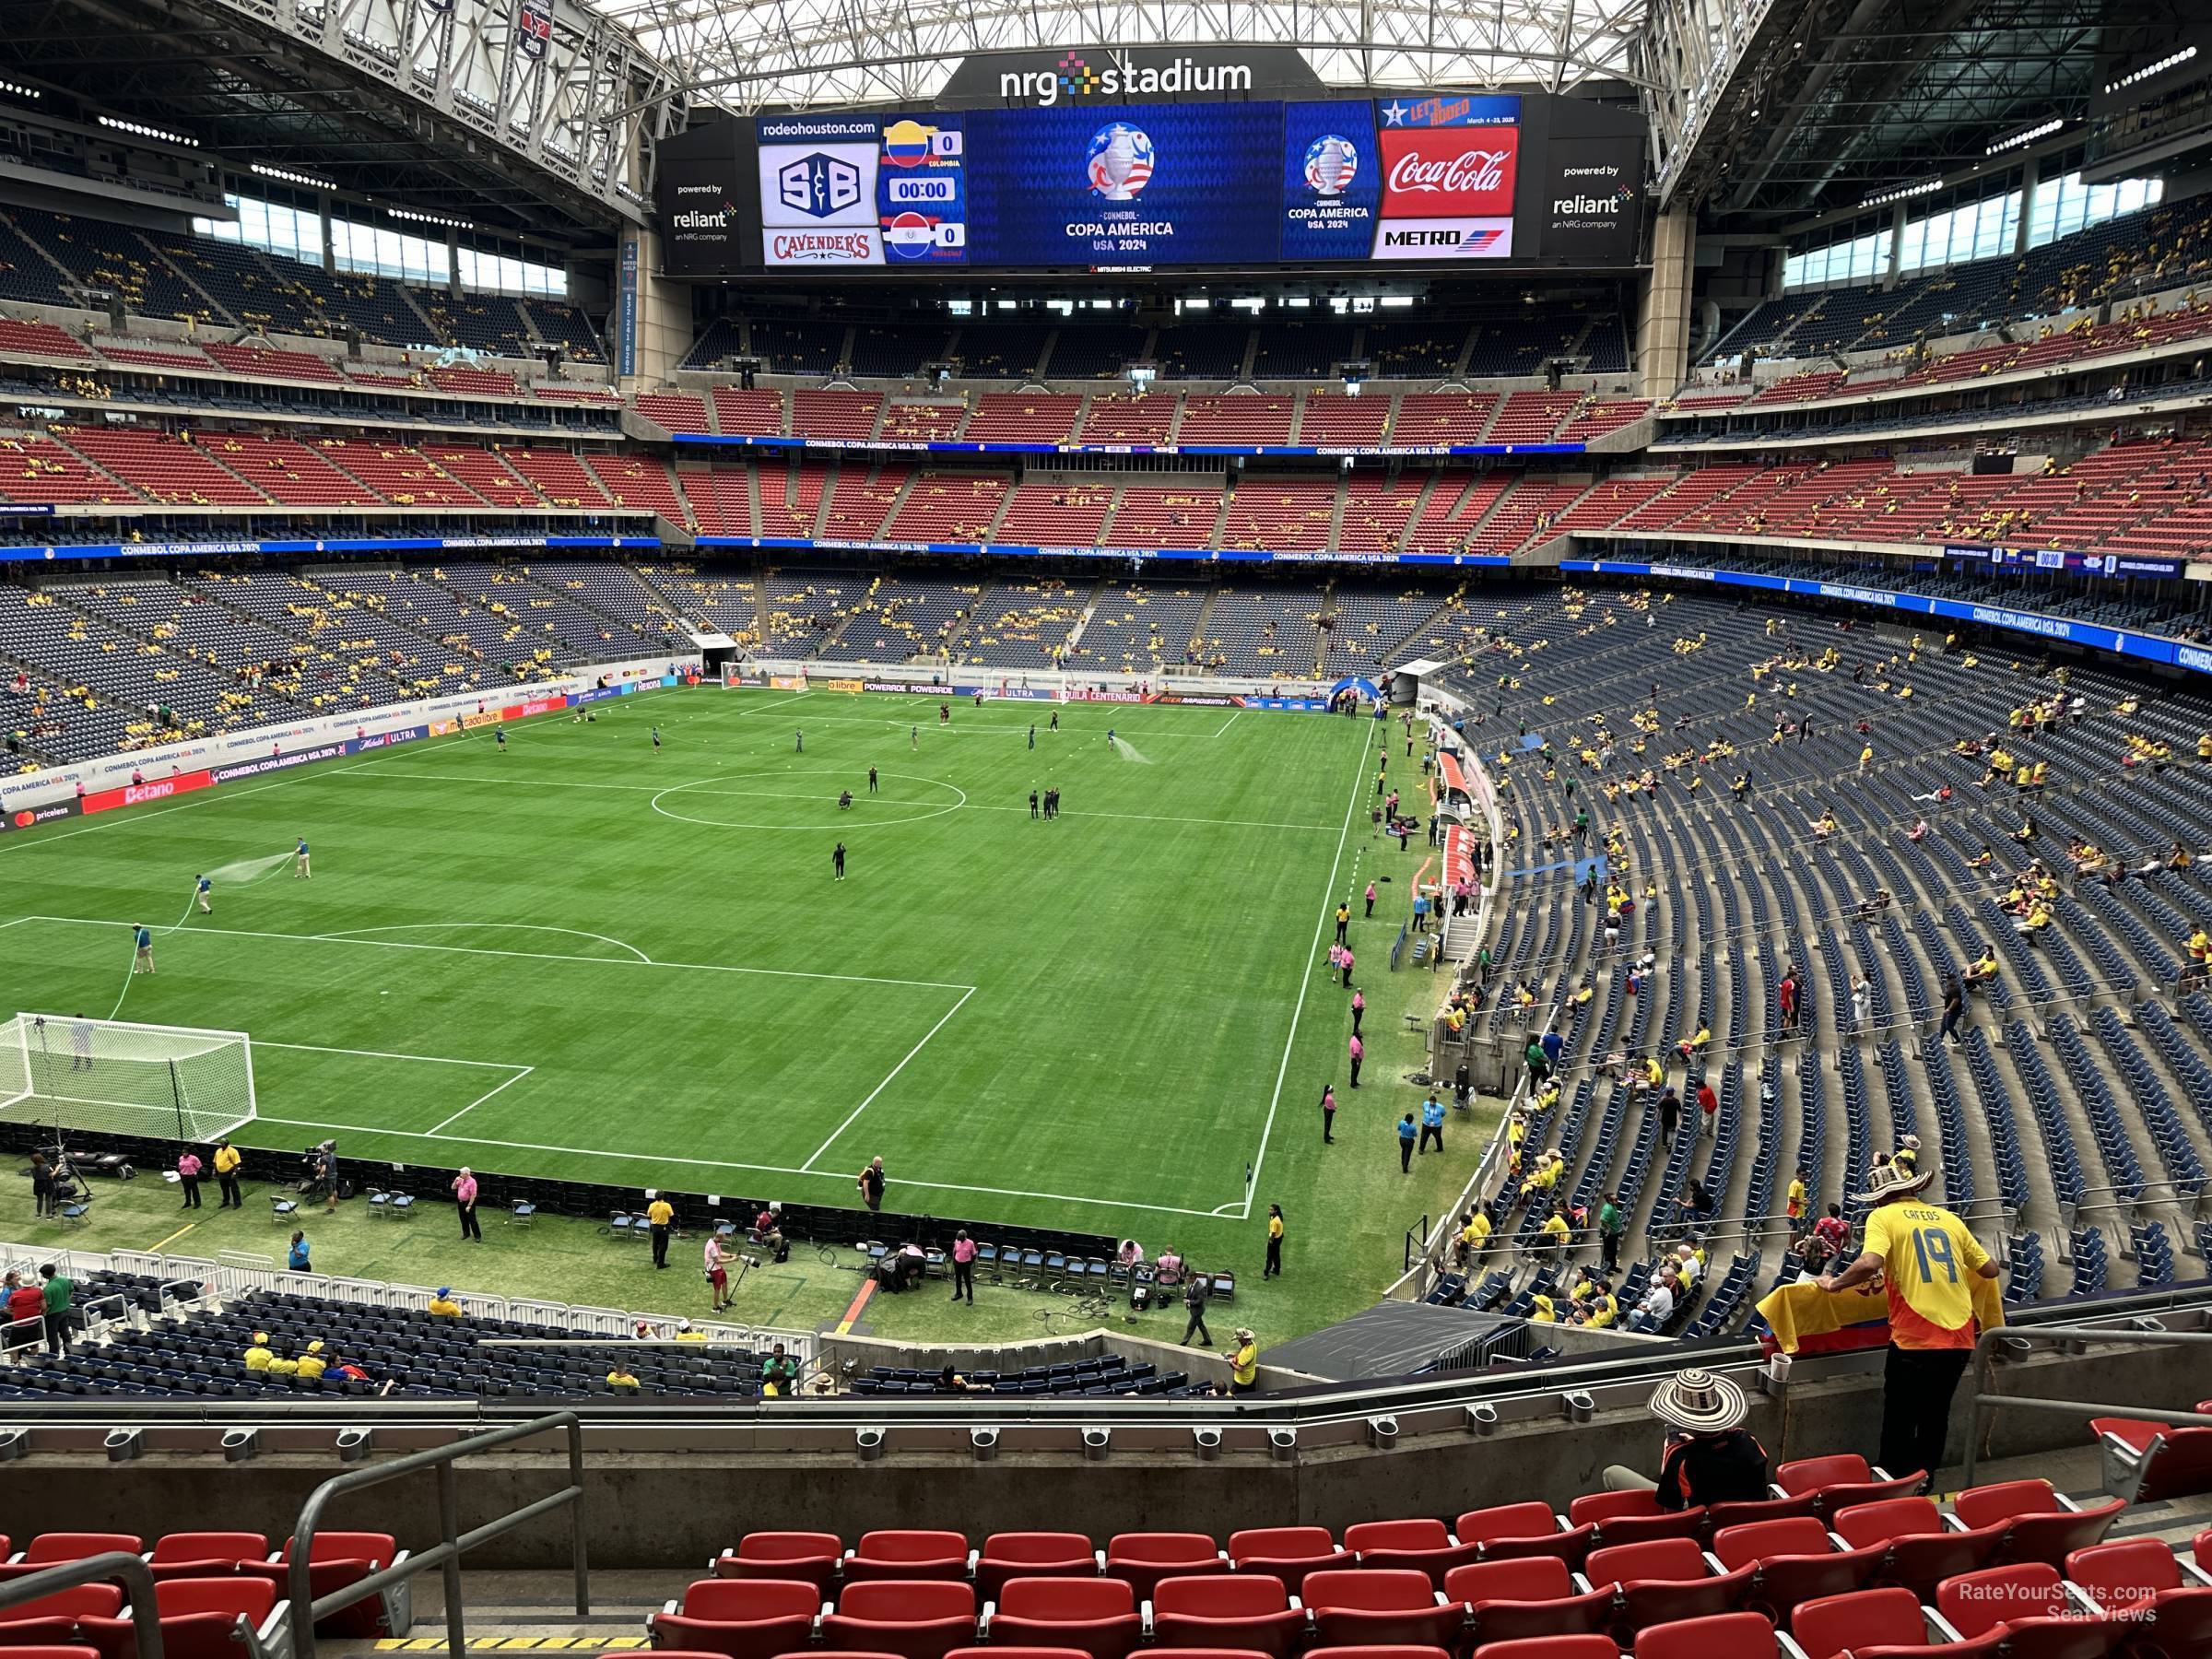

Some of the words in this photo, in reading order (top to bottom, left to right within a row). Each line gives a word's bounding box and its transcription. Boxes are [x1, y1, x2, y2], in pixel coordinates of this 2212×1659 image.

[525, 38, 541, 55] 2019
[1000, 72, 1058, 106] nrg
[1100, 58, 1252, 94] stadium
[763, 122, 876, 136] rodeohouston.com
[942, 135, 953, 151] 0
[1389, 150, 1512, 193] Coca-Cola
[1564, 166, 1606, 177] powered
[1606, 166, 1618, 177] by
[677, 184, 712, 194] powered
[712, 184, 723, 194] by
[899, 182, 947, 198] 00:00
[1553, 194, 1619, 214] reliant
[674, 210, 727, 228] reliant
[1288, 208, 1317, 218] COPA
[1319, 207, 1369, 218] AMERICA
[1066, 223, 1105, 237] COPA
[1107, 222, 1174, 236] AMERICA
[1307, 220, 1324, 229] USA
[1327, 220, 1348, 229] 2024
[1562, 220, 1581, 229] NRG
[1582, 221, 1617, 229] company
[945, 228, 955, 243] 0
[1385, 230, 1461, 247] METRO
[773, 233, 871, 260] CAVENDER'S
[1093, 240, 1115, 251] USA
[1119, 240, 1147, 251] 2024
[806, 440, 846, 448] CONMEBOL
[846, 441, 866, 449] COPA
[867, 441, 897, 450] AMERICA
[912, 442, 928, 451] 2024
[121, 546, 168, 556] CONMEBOL
[169, 545, 190, 554] COPA
[191, 544, 226, 553] AMERICA
[226, 544, 241, 552] USA
[241, 543, 261, 553] 2024
[442, 539, 477, 547] CONMEBOL
[493, 538, 520, 547] AMERICA
[812, 540, 852, 548] CONMEBOL
[851, 541, 870, 549] COPA
[869, 542, 899, 550] AMERICA
[912, 543, 929, 551] 2024
[1333, 553, 1366, 561] AMERICA
[1382, 554, 1400, 562] 2024
[2041, 553, 2059, 566] 00:00
[1973, 607, 2002, 623] CONMEBOL
[2002, 613, 2017, 627] COPA
[2016, 614, 2042, 631] AMERICA
[2042, 619, 2054, 634] USA
[2053, 622, 2070, 637] 2024
[638, 679, 661, 691] Rexona
[836, 680, 856, 689] libre
[864, 683, 906, 692] POWERADE
[911, 685, 954, 694] POWERADE
[1006, 689, 1034, 698] ULTRA
[1090, 691, 1141, 702] CENTENARIO
[481, 712, 499, 723] libre
[227, 738, 256, 748] CONMEBOL
[270, 731, 292, 740] AMERICA
[390, 729, 417, 743] ULTRA
[104, 760, 137, 772] CONMEBOL
[138, 758, 155, 766] COPA
[155, 752, 181, 762] AMERICA
[219, 765, 260, 780] CONMEBOL
[260, 760, 280, 771] COPA
[279, 754, 309, 768] AMERICA
[309, 751, 321, 759] USA
[321, 747, 336, 758] 2024
[2, 785, 21, 795] COPA
[21, 779, 51, 791] AMERICA
[51, 776, 64, 784] USA
[64, 773, 80, 782] 2024
[124, 782, 174, 805] Betano
[36, 807, 68, 821] priceless
[1912, 1227, 1958, 1283] 19
